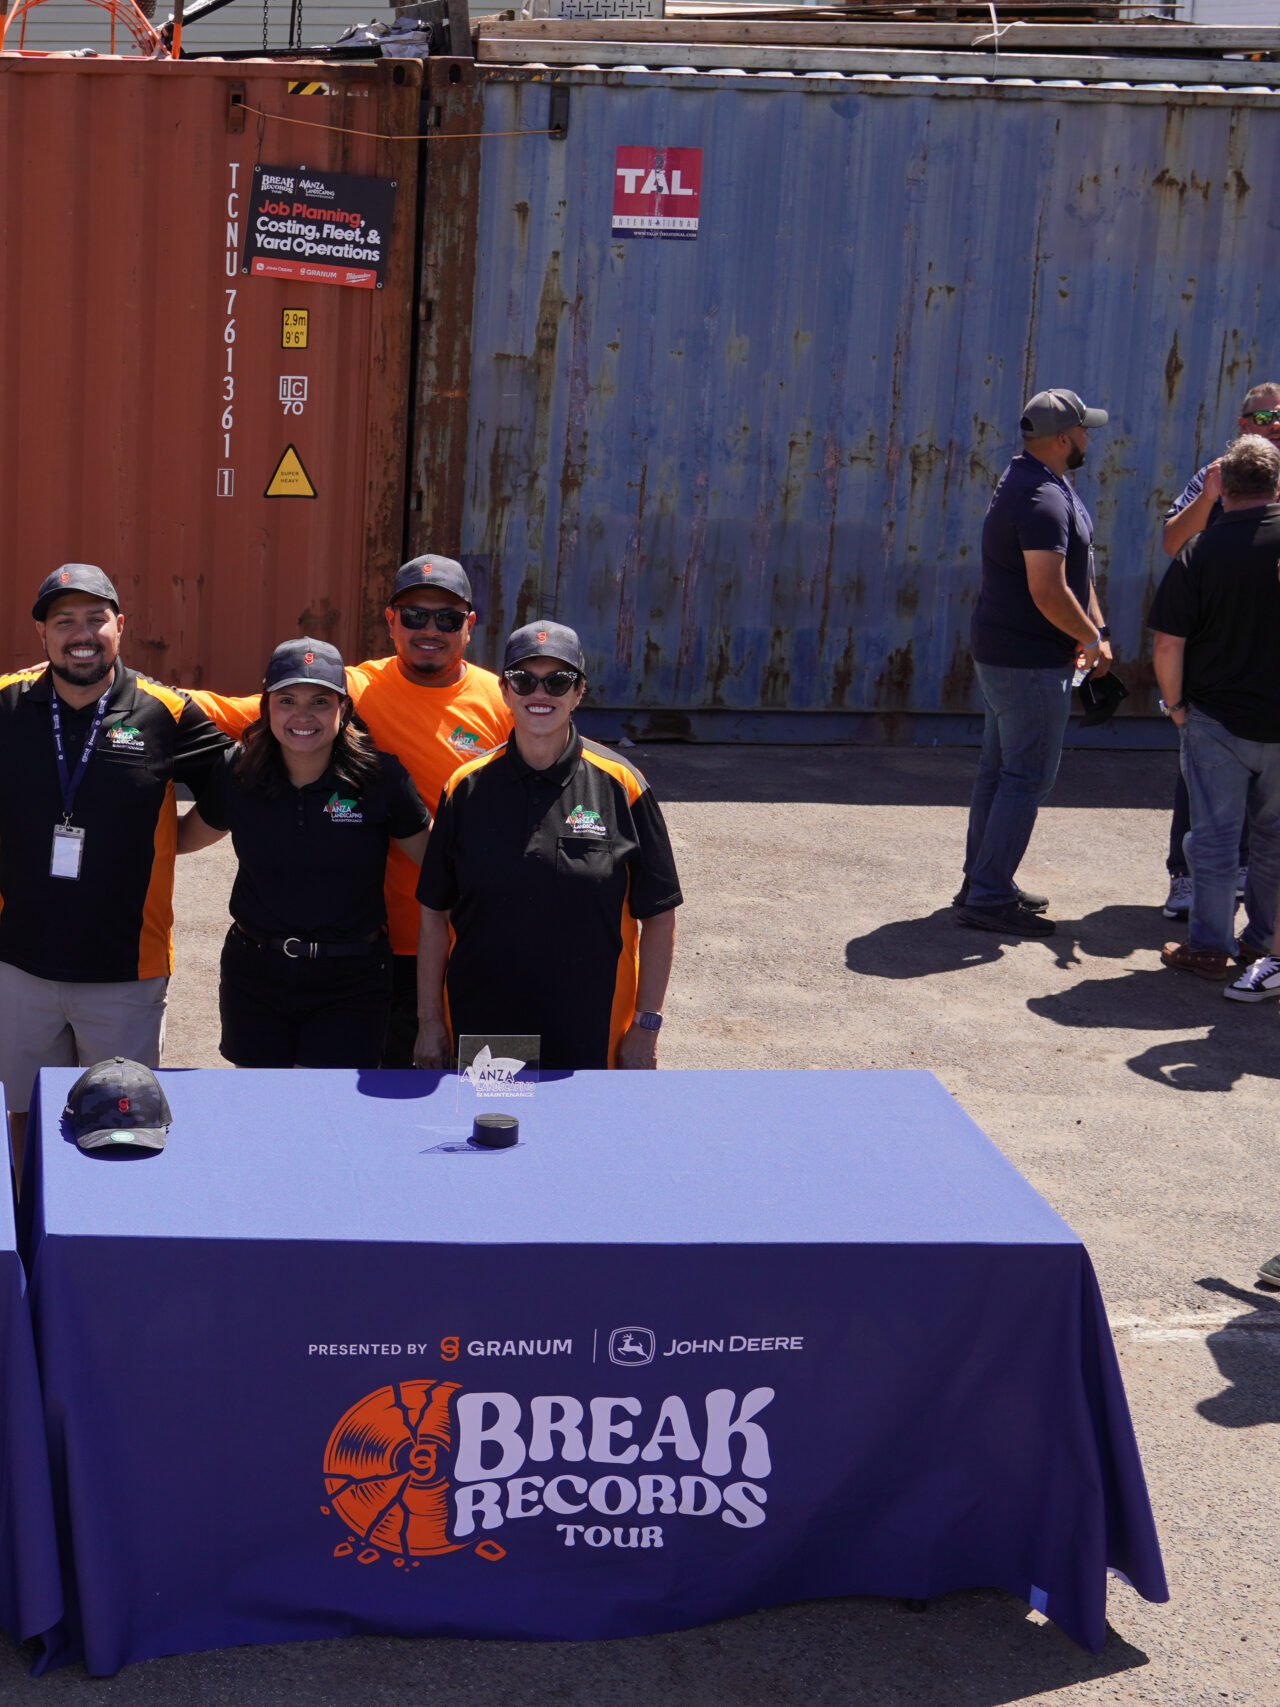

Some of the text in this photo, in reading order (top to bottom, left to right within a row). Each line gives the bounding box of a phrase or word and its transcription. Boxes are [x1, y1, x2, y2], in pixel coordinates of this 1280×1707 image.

[261, 184, 293, 194] RECORDS
[262, 175, 295, 188] BREAK
[299, 179, 324, 190] AVANZA
[616, 168, 693, 195] TAL
[225, 163, 240, 277] TCNU
[258, 200, 365, 228] Job Planning,
[256, 216, 381, 245] Costing, Fleet, &
[255, 233, 380, 262] Yard Operations
[306, 269, 337, 278] GRANUM
[285, 314, 306, 326] 2.9m
[221, 289, 237, 458] 761361
[281, 401, 304, 415] 70
[308, 1343, 402, 1356] PRESENTED
[407, 1343, 428, 1355] BY
[467, 1339, 572, 1357] GRANUM
[663, 1335, 804, 1357] JOHN DEERE
[453, 1387, 775, 1482] BREAK
[453, 1474, 768, 1537] RECORDS
[556, 1524, 664, 1548] TOUR
